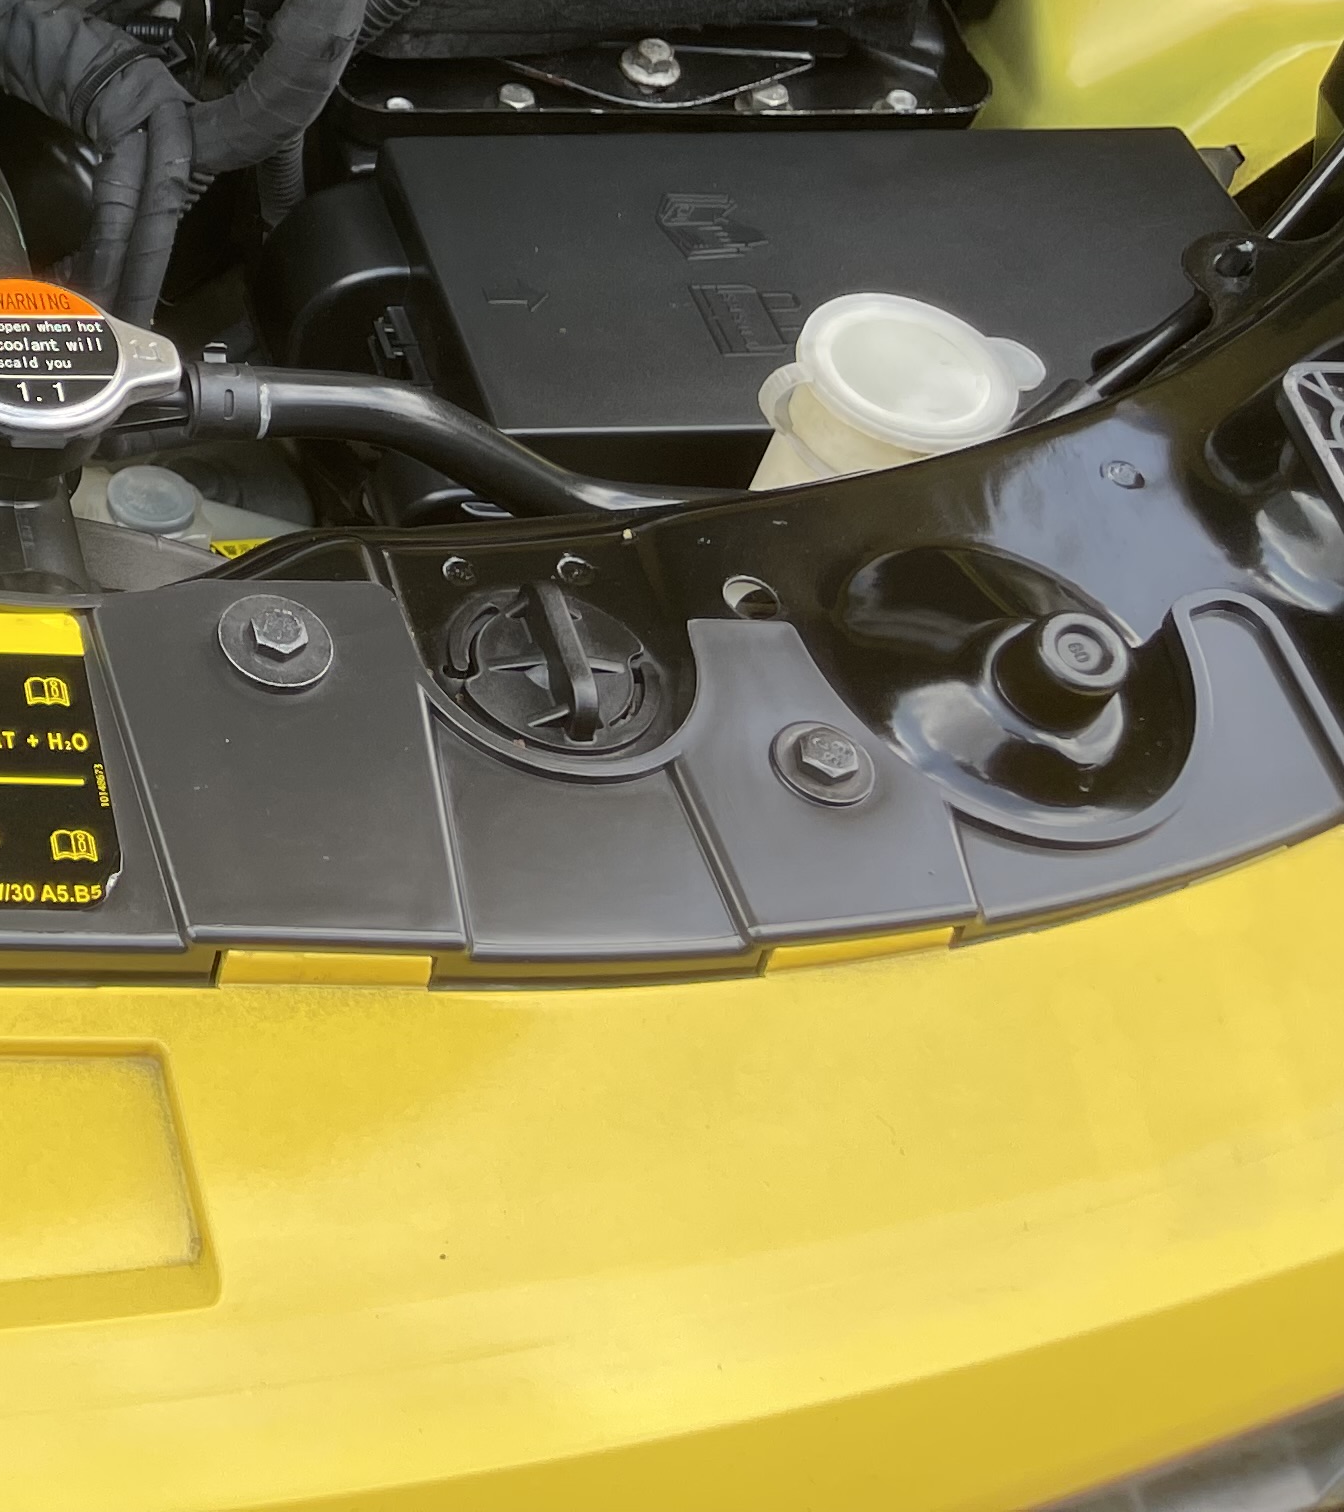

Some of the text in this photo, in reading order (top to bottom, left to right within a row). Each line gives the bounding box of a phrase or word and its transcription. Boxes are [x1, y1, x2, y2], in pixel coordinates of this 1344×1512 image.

[37, 319, 71, 333] when
[77, 319, 103, 333] hot
[66, 337, 102, 352] will
[46, 357, 72, 371] you
[16, 381, 65, 402] 1.1
[26, 734, 39, 748] +
[40, 884, 103, 903] A5.B5
